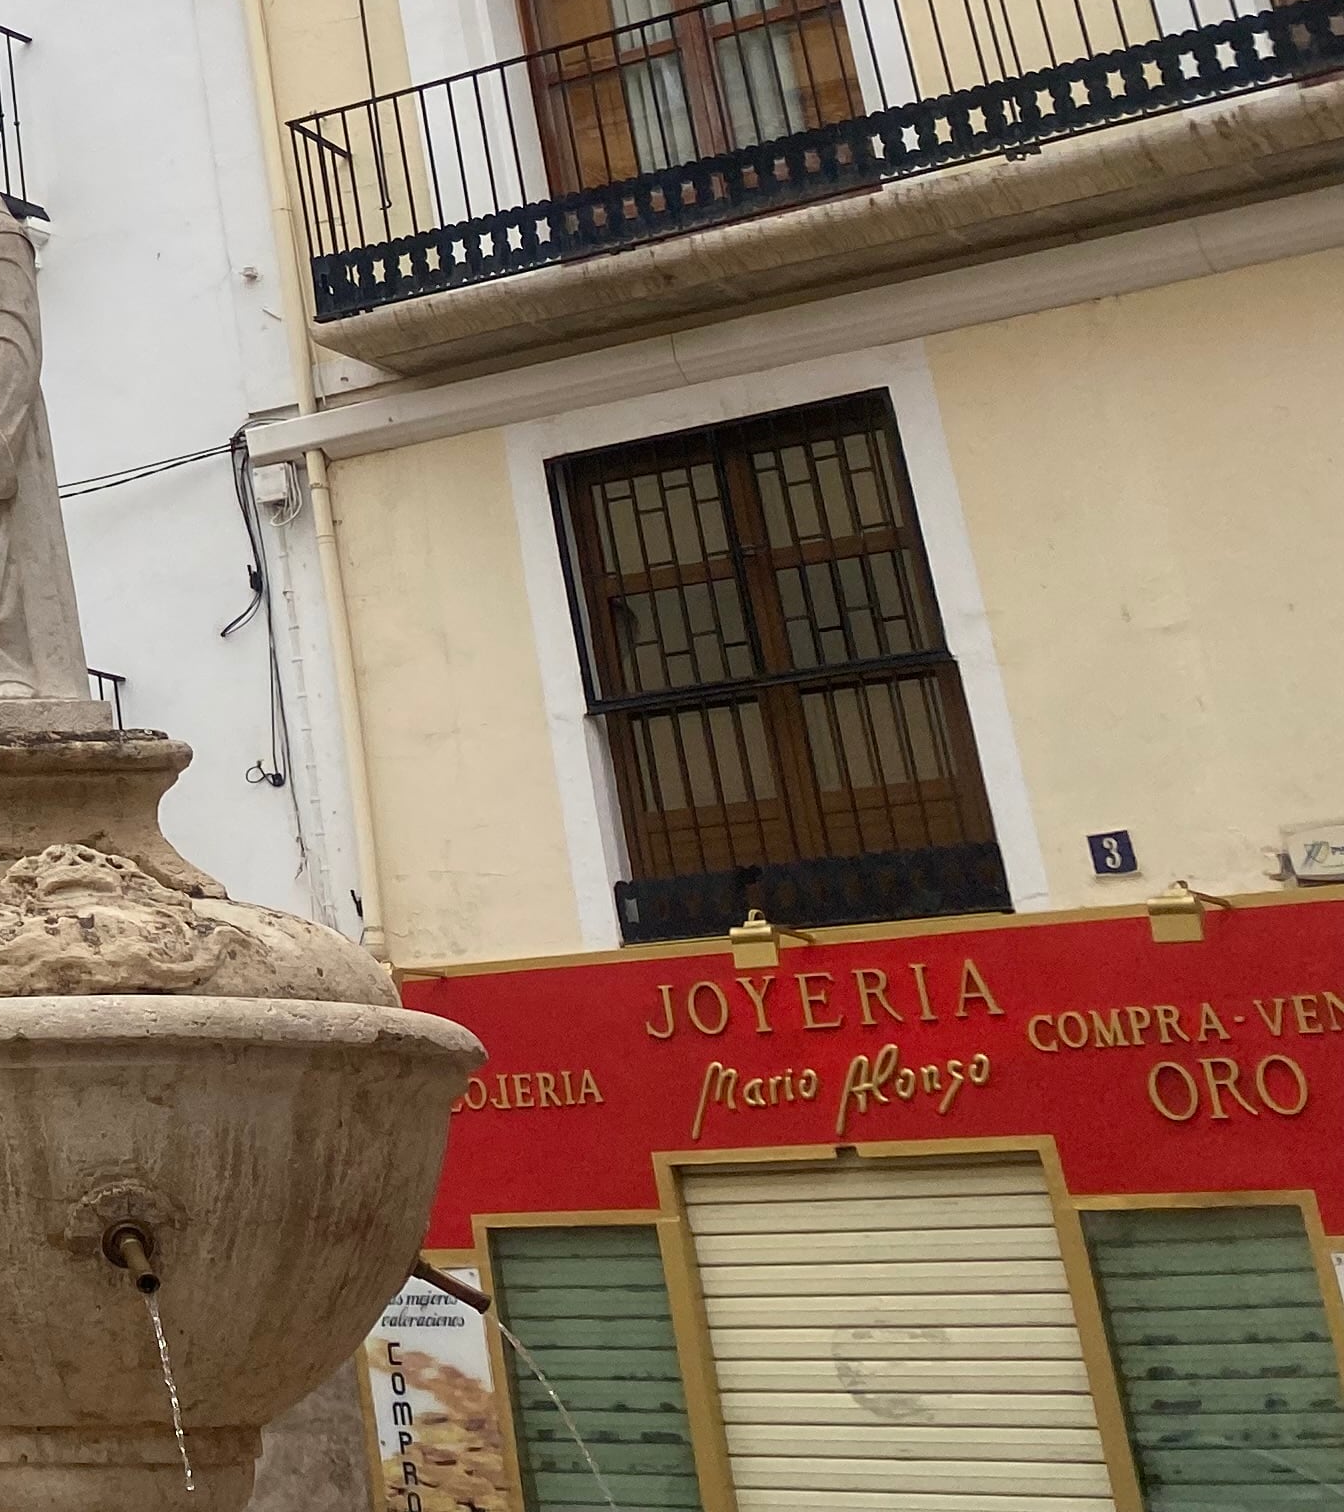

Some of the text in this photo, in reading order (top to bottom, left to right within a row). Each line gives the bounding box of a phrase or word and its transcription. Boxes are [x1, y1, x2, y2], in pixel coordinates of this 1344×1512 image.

[1102, 836, 1122, 870] 3
[645, 959, 1005, 1039] JOYERIA
[451, 1069, 605, 1113] OJERIA
[691, 1043, 990, 1140] Mario Alonso
[1147, 1053, 1308, 1122] ORO
[381, 1307, 465, 1327] valoraciones
[387, 1342, 422, 1512] COMPRO
